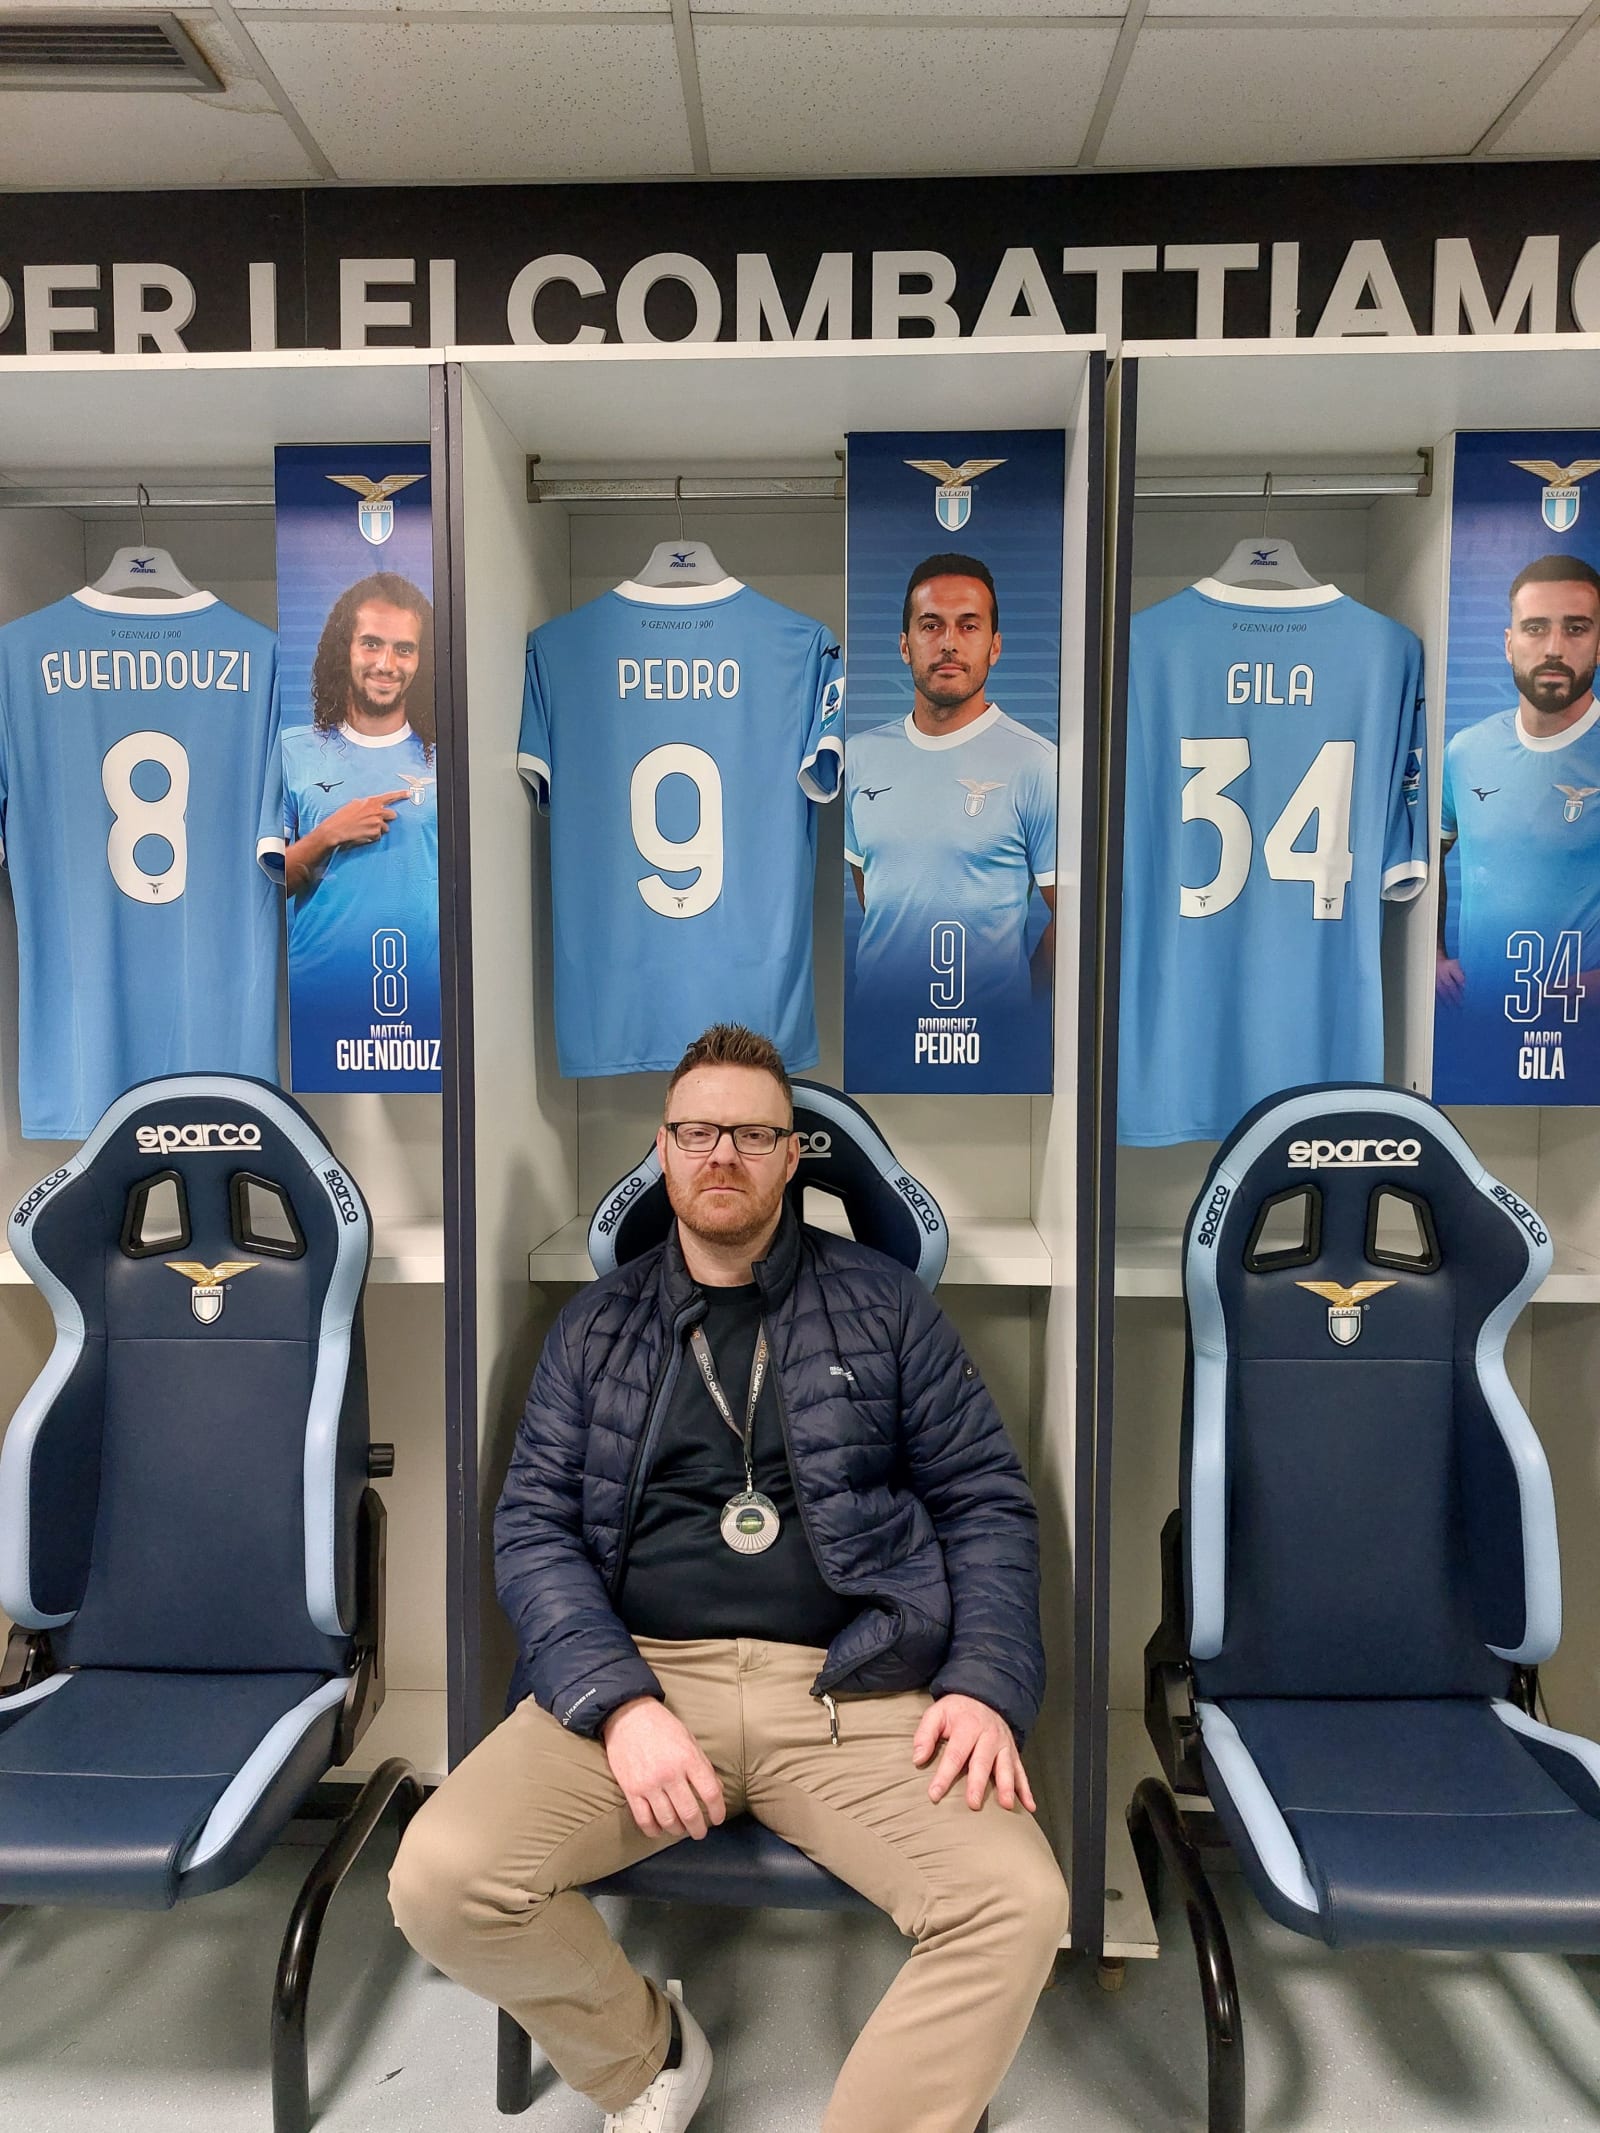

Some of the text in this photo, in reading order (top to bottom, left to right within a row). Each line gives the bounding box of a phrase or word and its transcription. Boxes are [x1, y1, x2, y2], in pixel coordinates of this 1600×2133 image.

[0, 263, 197, 355] ER
[249, 258, 457, 351] LEI
[118, 630, 160, 640] GENNAIO
[162, 629, 182, 640] 1900
[640, 619, 714, 630] 9 GENNAIO 1900
[1231, 622, 1308, 633] 9 GENNAIO 1900
[41, 649, 251, 695] GUENDOUZI
[617, 657, 741, 700] PEDRO
[1226, 661, 1315, 707] GILA
[101, 730, 190, 905] 8
[630, 742, 724, 919] 9
[1179, 736, 1356, 920] 34
[372, 928, 408, 1016] 8
[930, 921, 966, 1010] 9
[1502, 930, 1586, 1023] 34
[914, 1032, 980, 1064] PEDRO
[918, 1017, 978, 1033] RODRIGUEZ
[1523, 1031, 1562, 1047] MARIO
[336, 1039, 442, 1071] GUENDOUZ
[1518, 1046, 1566, 1080] GILA
[136, 1123, 262, 1154] sparco
[1287, 1138, 1422, 1170] sparco
[13, 1167, 72, 1227] sparco
[323, 1168, 358, 1226] sparco
[597, 1176, 647, 1237] sparco
[894, 1175, 940, 1235] sparco
[1197, 1184, 1231, 1249] sparco
[1489, 1184, 1548, 1248] sparco
[757, 1339, 768, 1362] TOUR
[699, 1353, 730, 1416] STADIO OLIMPICO
[751, 1363, 764, 1402] OLIMPICO
